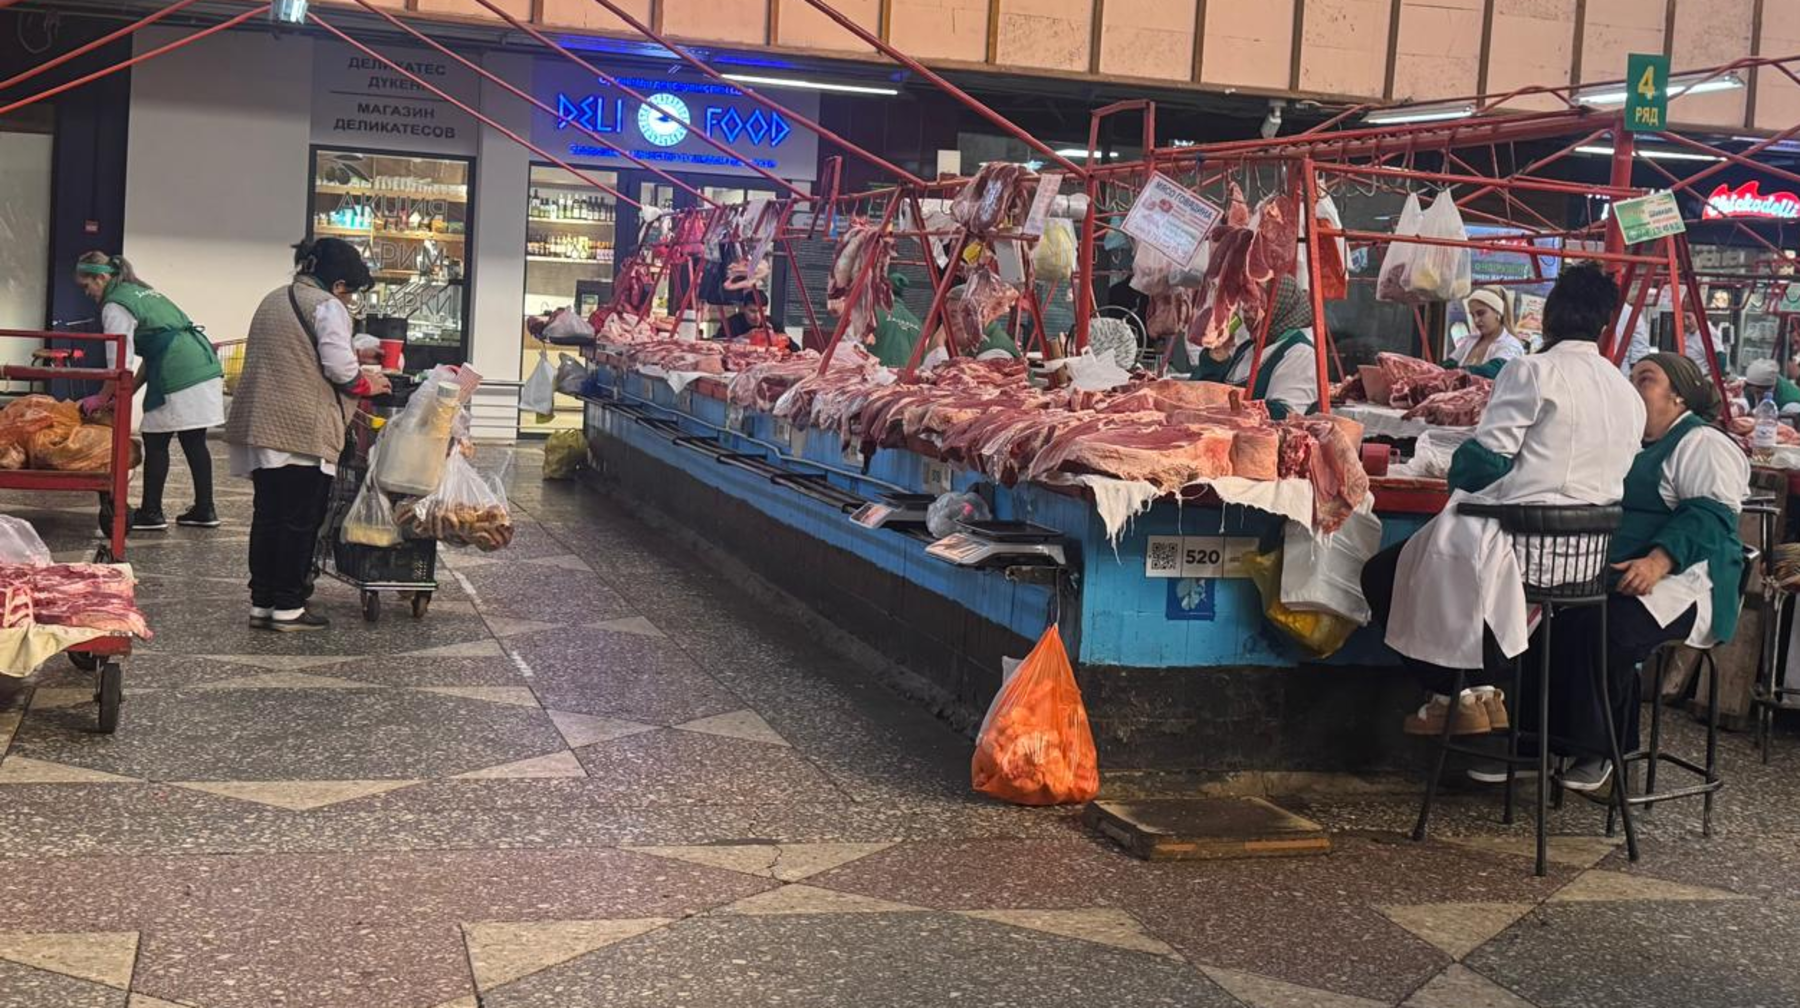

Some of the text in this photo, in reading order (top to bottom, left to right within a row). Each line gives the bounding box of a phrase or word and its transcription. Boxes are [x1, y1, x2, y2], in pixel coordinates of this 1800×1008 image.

[347, 57, 446, 75] ДЕЛИКАТЕС
[1637, 65, 1656, 100] 4
[356, 102, 436, 119] МАГАЗИН
[557, 92, 791, 148] DELI FOOD
[1634, 106, 1659, 127] РЯД
[333, 118, 456, 139] ДЕЛИКАТЕСОВ
[335, 191, 449, 225] АКЦИЯ
[359, 241, 445, 273] АРИМ
[346, 289, 453, 319] ОДАРКИ
[1185, 549, 1221, 565] 520
